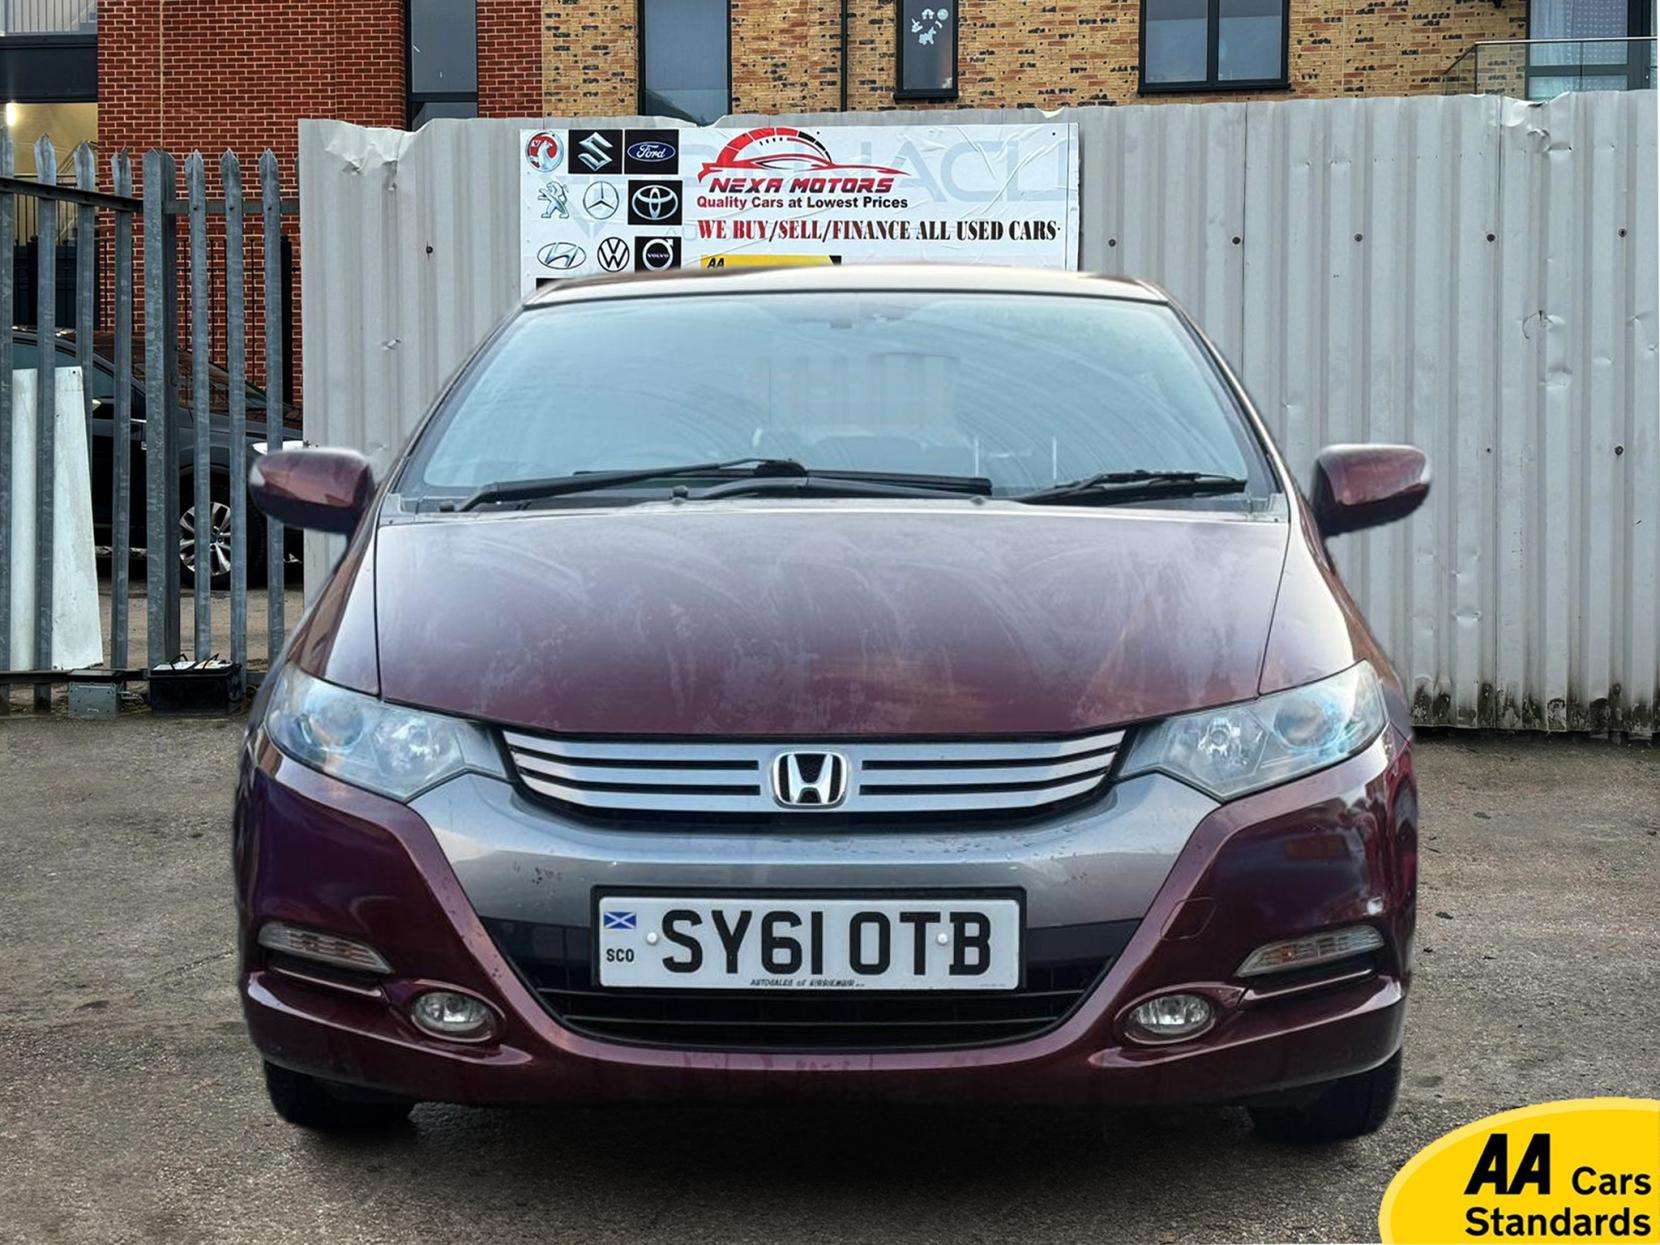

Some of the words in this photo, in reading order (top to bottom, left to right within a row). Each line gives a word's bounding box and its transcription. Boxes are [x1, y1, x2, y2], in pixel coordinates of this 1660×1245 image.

[635, 144, 667, 159] Ford
[709, 178, 784, 193] NEXA
[789, 178, 895, 193] MOTORS
[697, 196, 747, 210] Quality
[752, 196, 784, 208] Cars
[788, 197, 803, 208] at
[807, 196, 858, 208] Lowest
[863, 196, 908, 208] Prices
[697, 219, 727, 240] WE
[732, 219, 911, 243] BUY/SELL/FINANCE
[915, 220, 951, 240] ALL
[956, 220, 1004, 240] USED
[1008, 220, 1057, 240] CARS
[706, 257, 725, 268] AA
[662, 909, 824, 975] SY61
[849, 911, 991, 975] OTB
[606, 948, 635, 963] SCO
